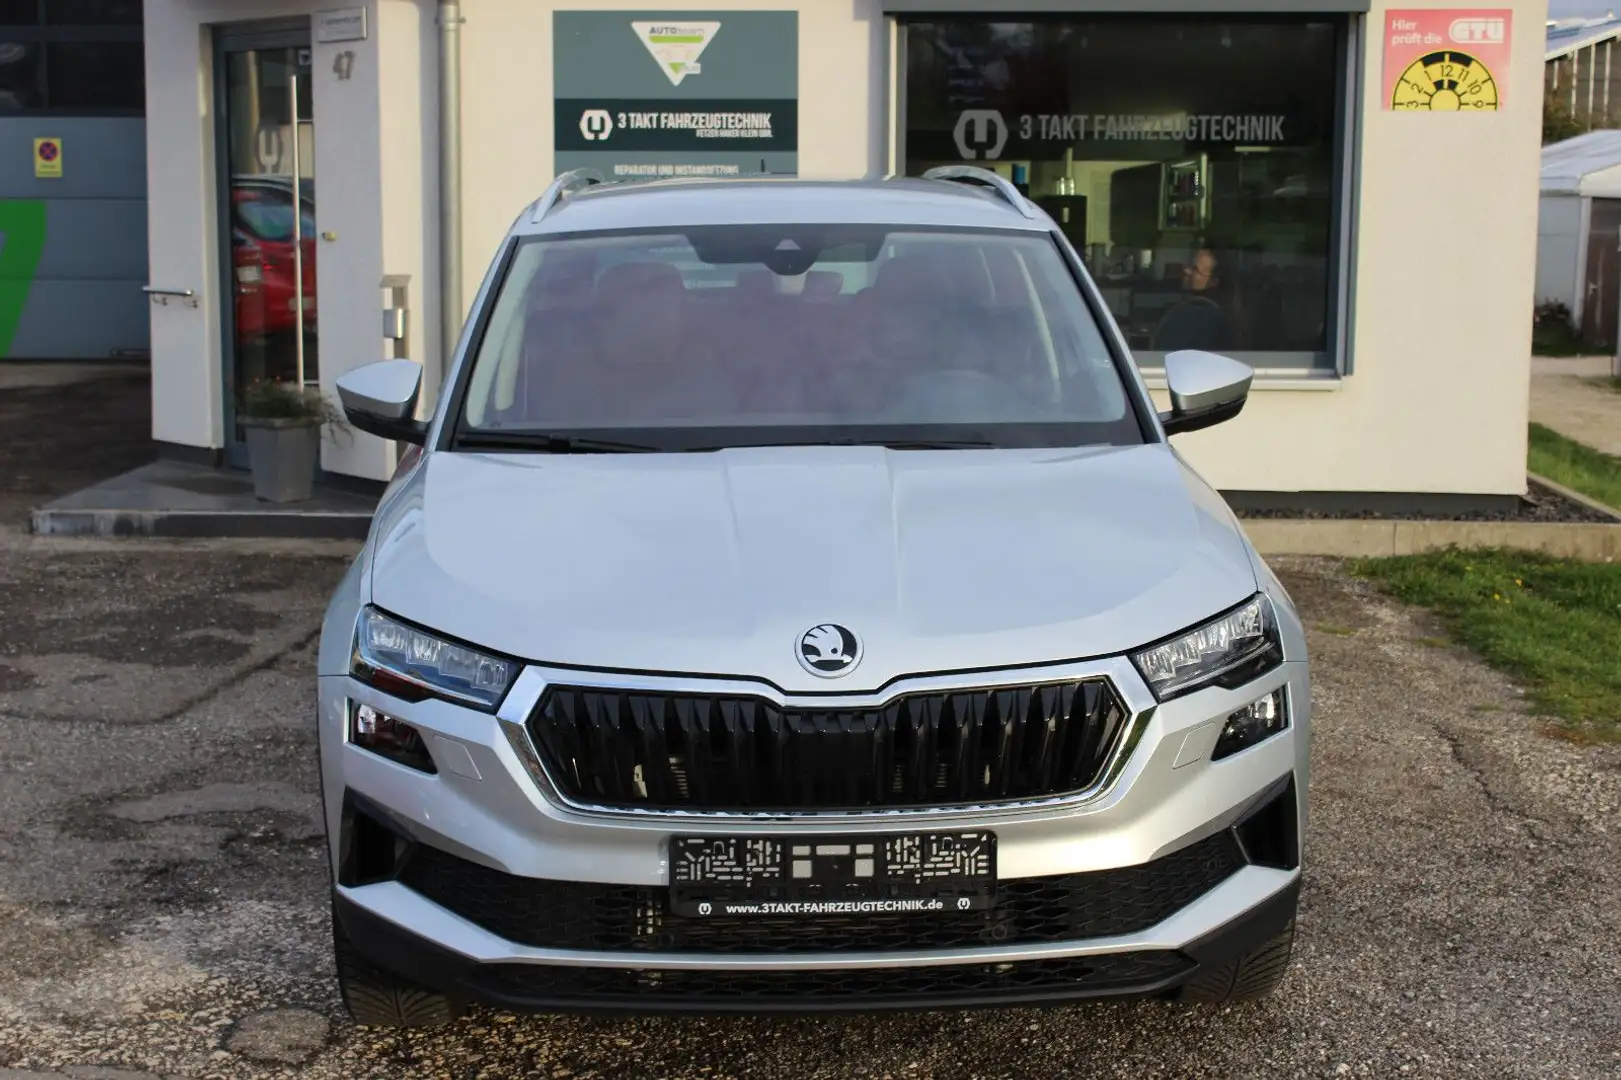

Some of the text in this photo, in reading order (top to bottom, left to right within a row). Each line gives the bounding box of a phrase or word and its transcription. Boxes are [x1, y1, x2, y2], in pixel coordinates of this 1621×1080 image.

[1392, 19, 1417, 30] Hier
[1392, 32, 1442, 46] prüft die
[1440, 65, 1453, 78] 12
[1458, 68, 1470, 82] 11
[1411, 83, 1424, 94] 2
[1467, 79, 1482, 95] 10
[1406, 100, 1419, 109] 3
[617, 112, 772, 129] 3 TAKT FAHRZEUGTECHNIK
[1020, 115, 1286, 141] 3 TAKT FAHRZEUGTECHNIK
[726, 899, 943, 914] www.3TAKT-FAHRZEUGTECHNIK.de
